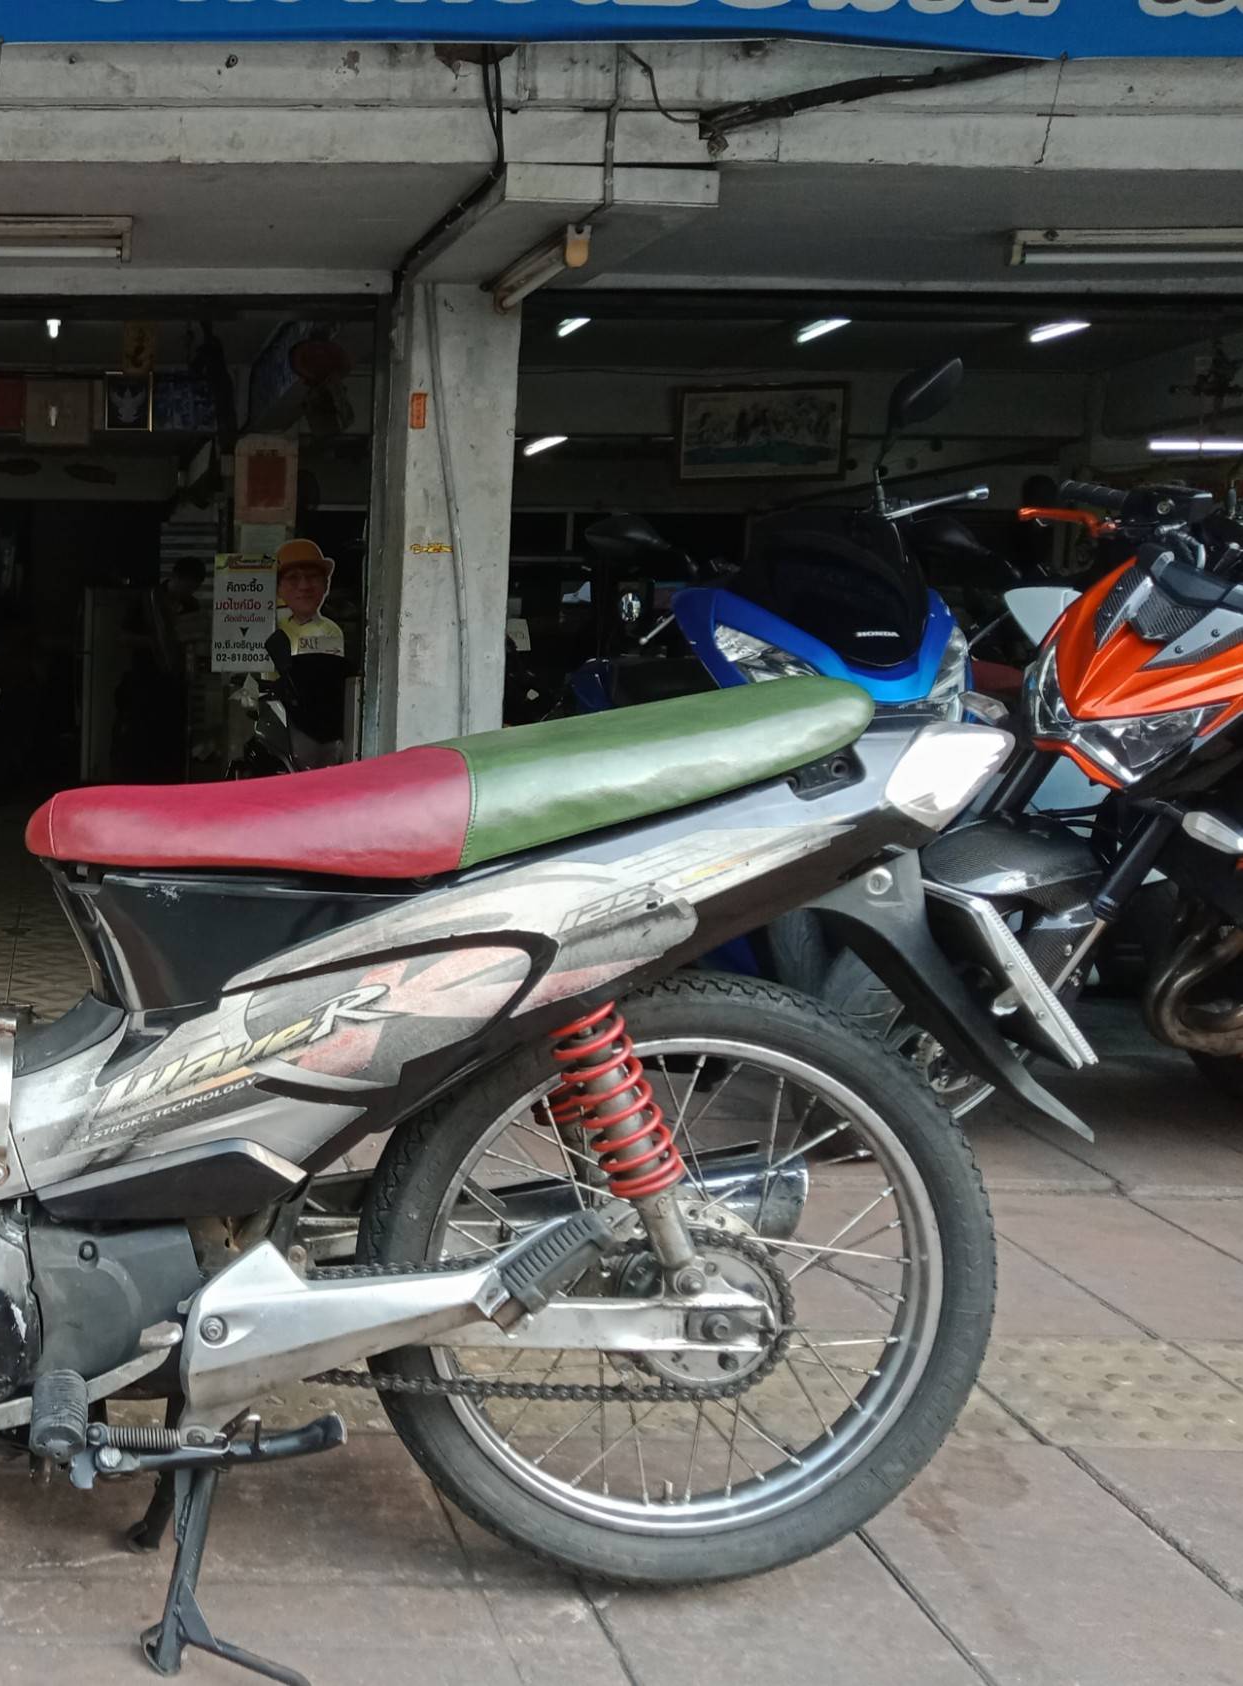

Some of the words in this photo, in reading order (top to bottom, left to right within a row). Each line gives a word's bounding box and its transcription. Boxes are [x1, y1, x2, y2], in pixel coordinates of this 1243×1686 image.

[226, 577, 264, 593] คิดจะซื้อ
[267, 600, 274, 610] 2
[856, 630, 900, 638] HONDA
[92, 1113, 152, 1140] STROKE
[155, 1075, 257, 1118] TECHNOLOGY
